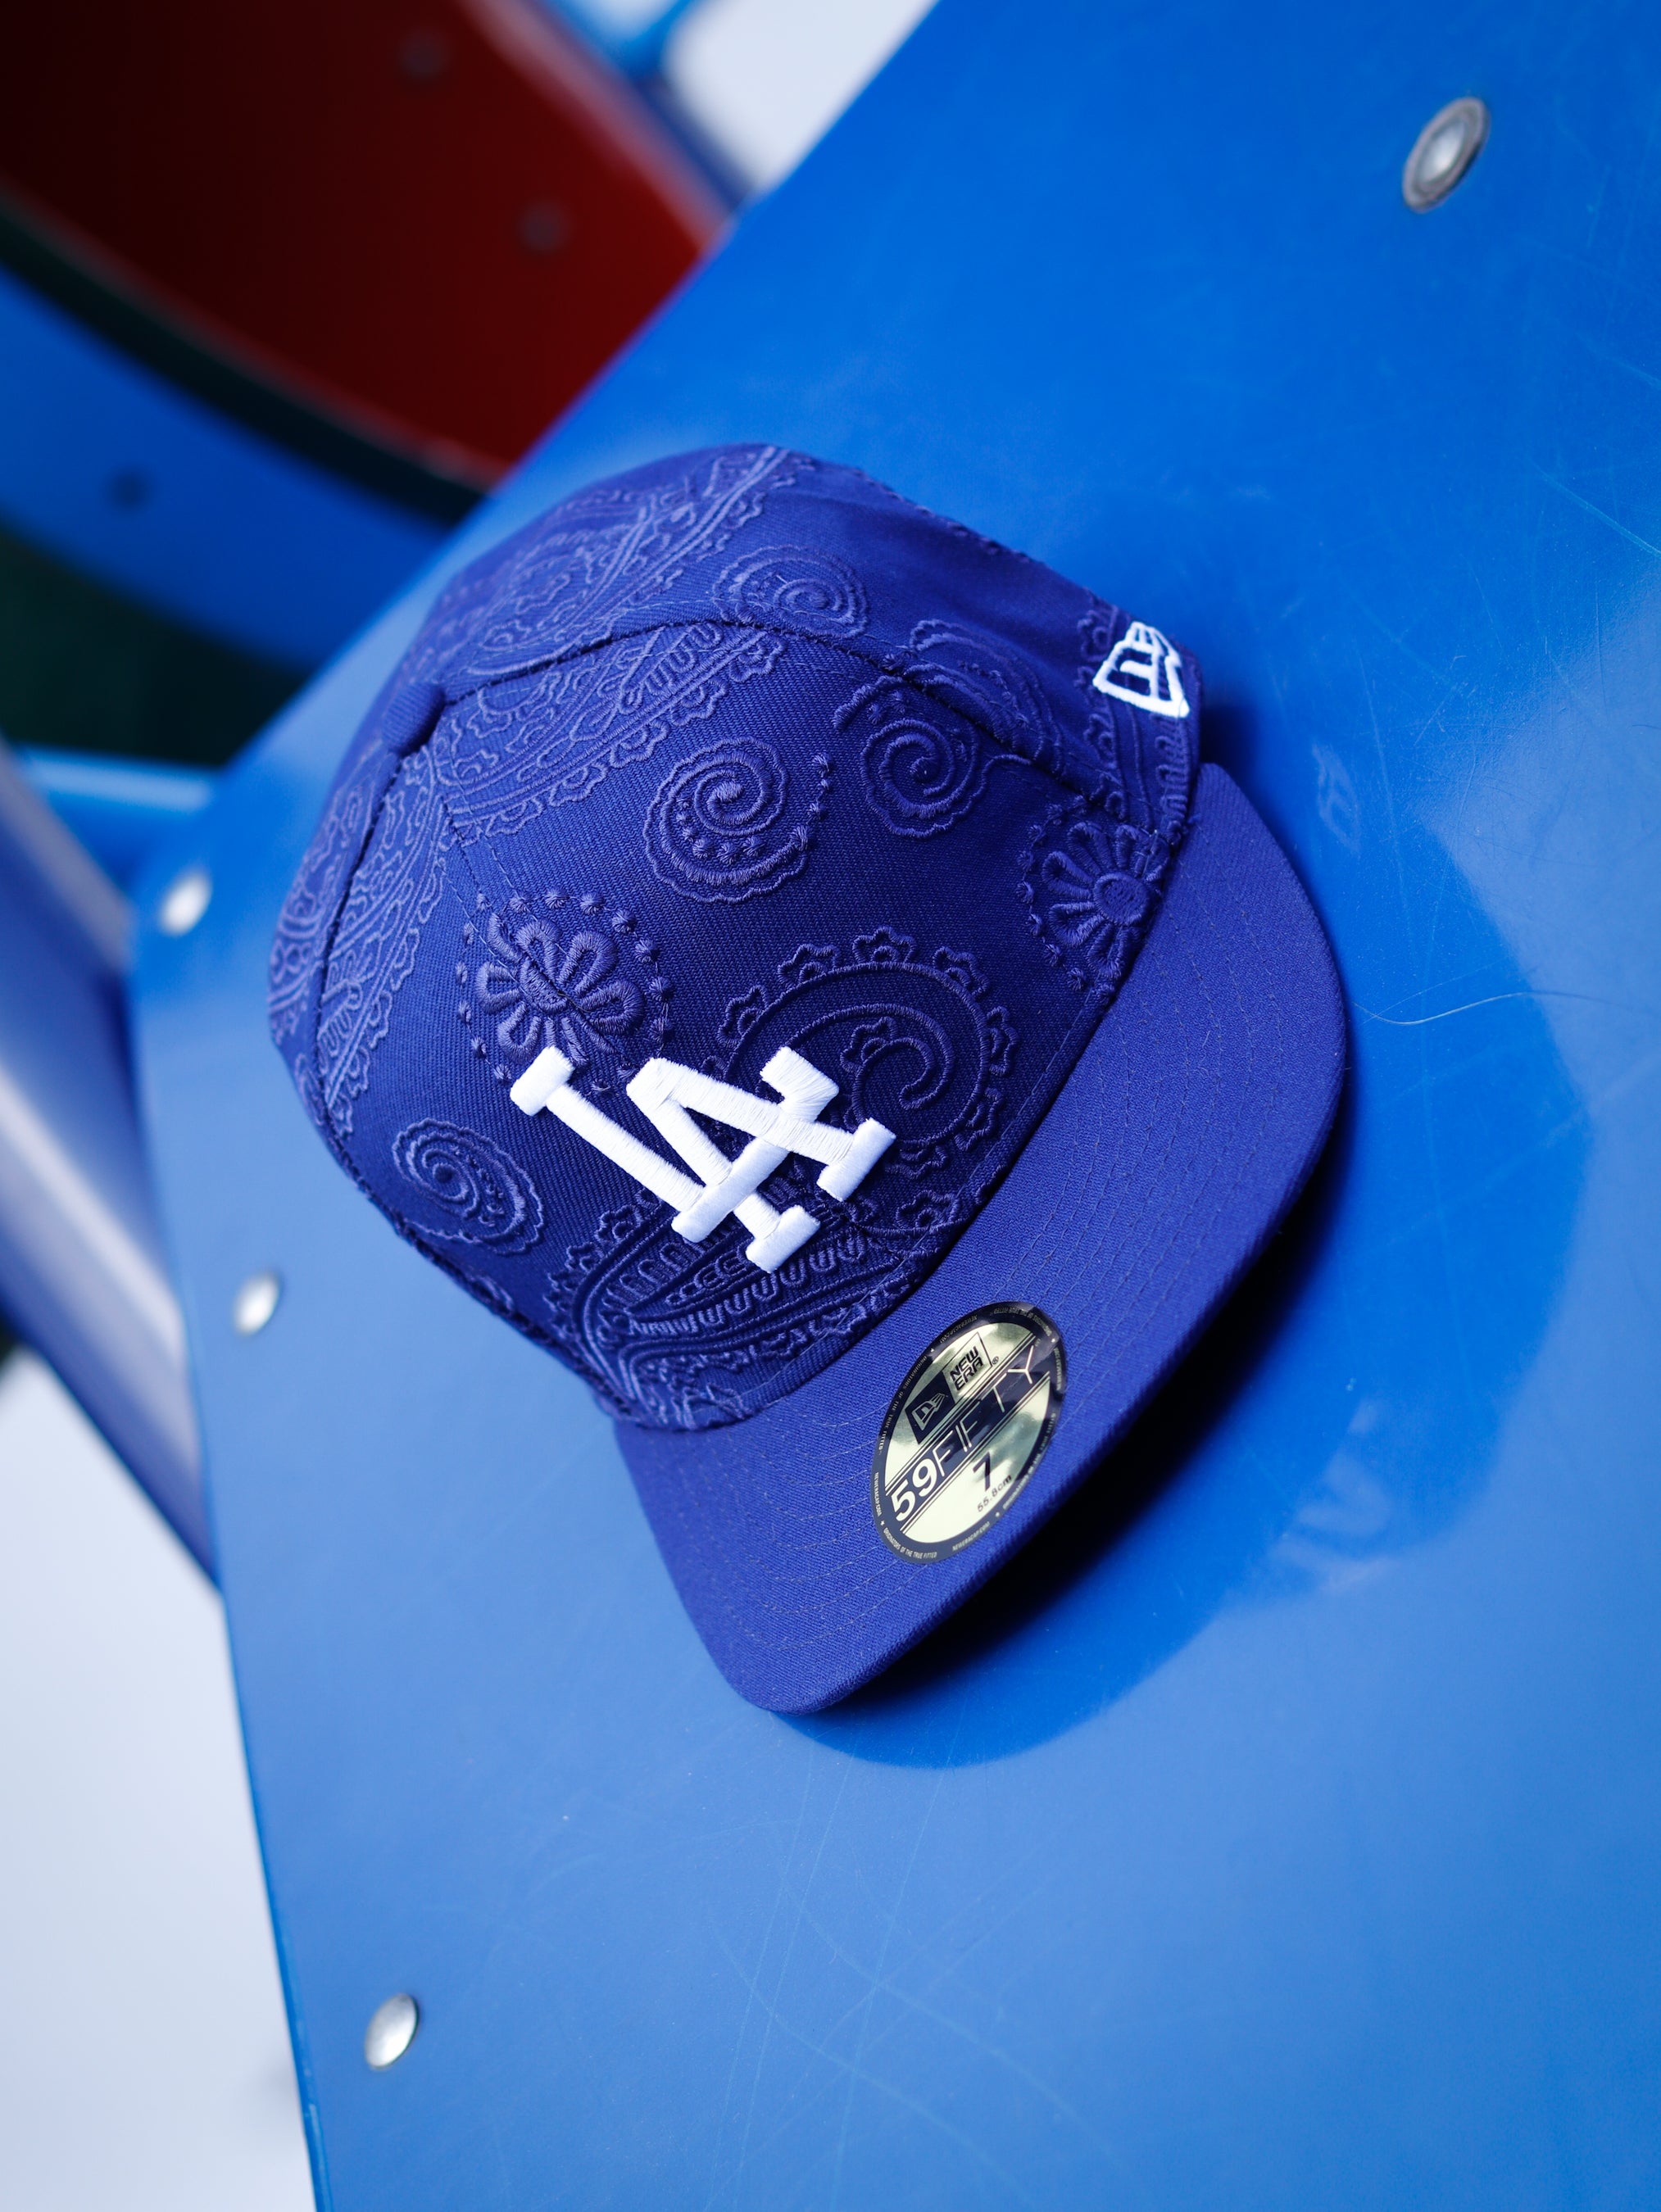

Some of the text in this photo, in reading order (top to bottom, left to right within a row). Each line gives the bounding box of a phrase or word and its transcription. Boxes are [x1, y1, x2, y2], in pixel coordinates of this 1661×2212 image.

[509, 1045, 897, 1273] LA
[949, 1346, 979, 1382] NEW
[955, 1357, 984, 1391] ERA
[891, 1344, 1034, 1522] 59FIFTY
[972, 1451, 992, 1492] 7
